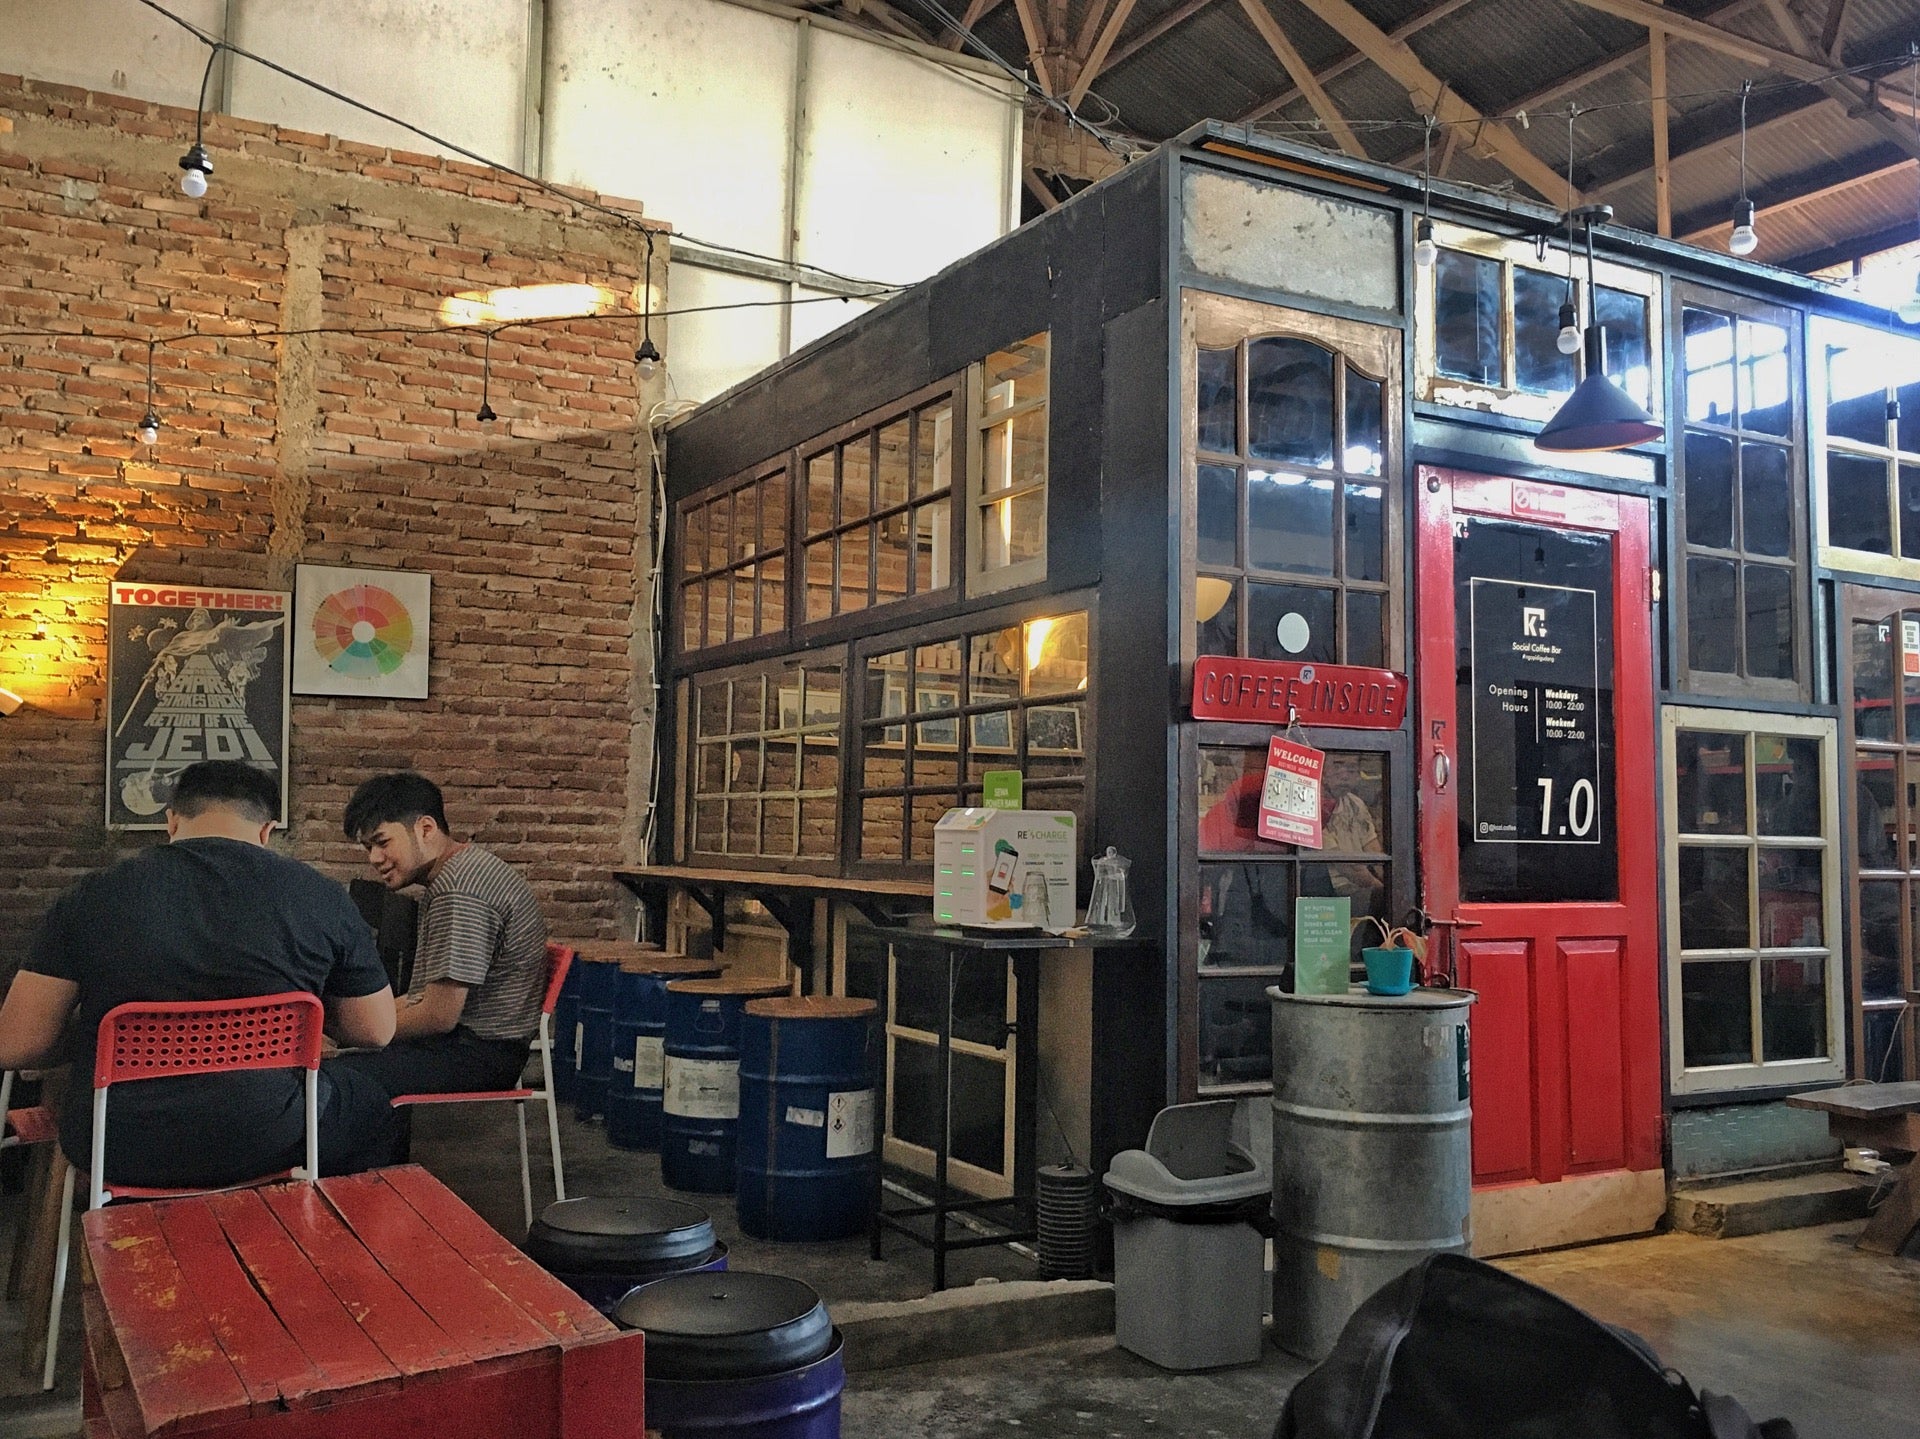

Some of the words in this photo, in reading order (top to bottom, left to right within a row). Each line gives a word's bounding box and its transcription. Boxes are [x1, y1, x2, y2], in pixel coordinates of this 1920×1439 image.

[116, 588, 283, 611] TOGETHER!
[1512, 641, 1530, 651] Social
[1531, 643, 1550, 653] Coffee
[1551, 645, 1562, 654] Bar
[1203, 671, 1298, 709] COFFEE
[1309, 680, 1397, 715] INSIDE
[1488, 684, 1528, 700] Opening
[1545, 688, 1579, 701] Weekdays
[157, 693, 206, 707] STRIKES
[1502, 701, 1529, 713] Hours
[1545, 700, 1562, 710] 10:00
[1566, 701, 1585, 711] 22:00
[143, 712, 200, 727] RETURN
[205, 714, 221, 728] OF
[222, 714, 254, 728] THE
[1545, 717, 1576, 728] Weekend
[1546, 728, 1563, 738] 10:00
[1567, 730, 1585, 740] 22:00
[126, 728, 274, 761] JEDI
[1273, 747, 1319, 769] WELCOME
[1537, 778, 1594, 837] 1.0
